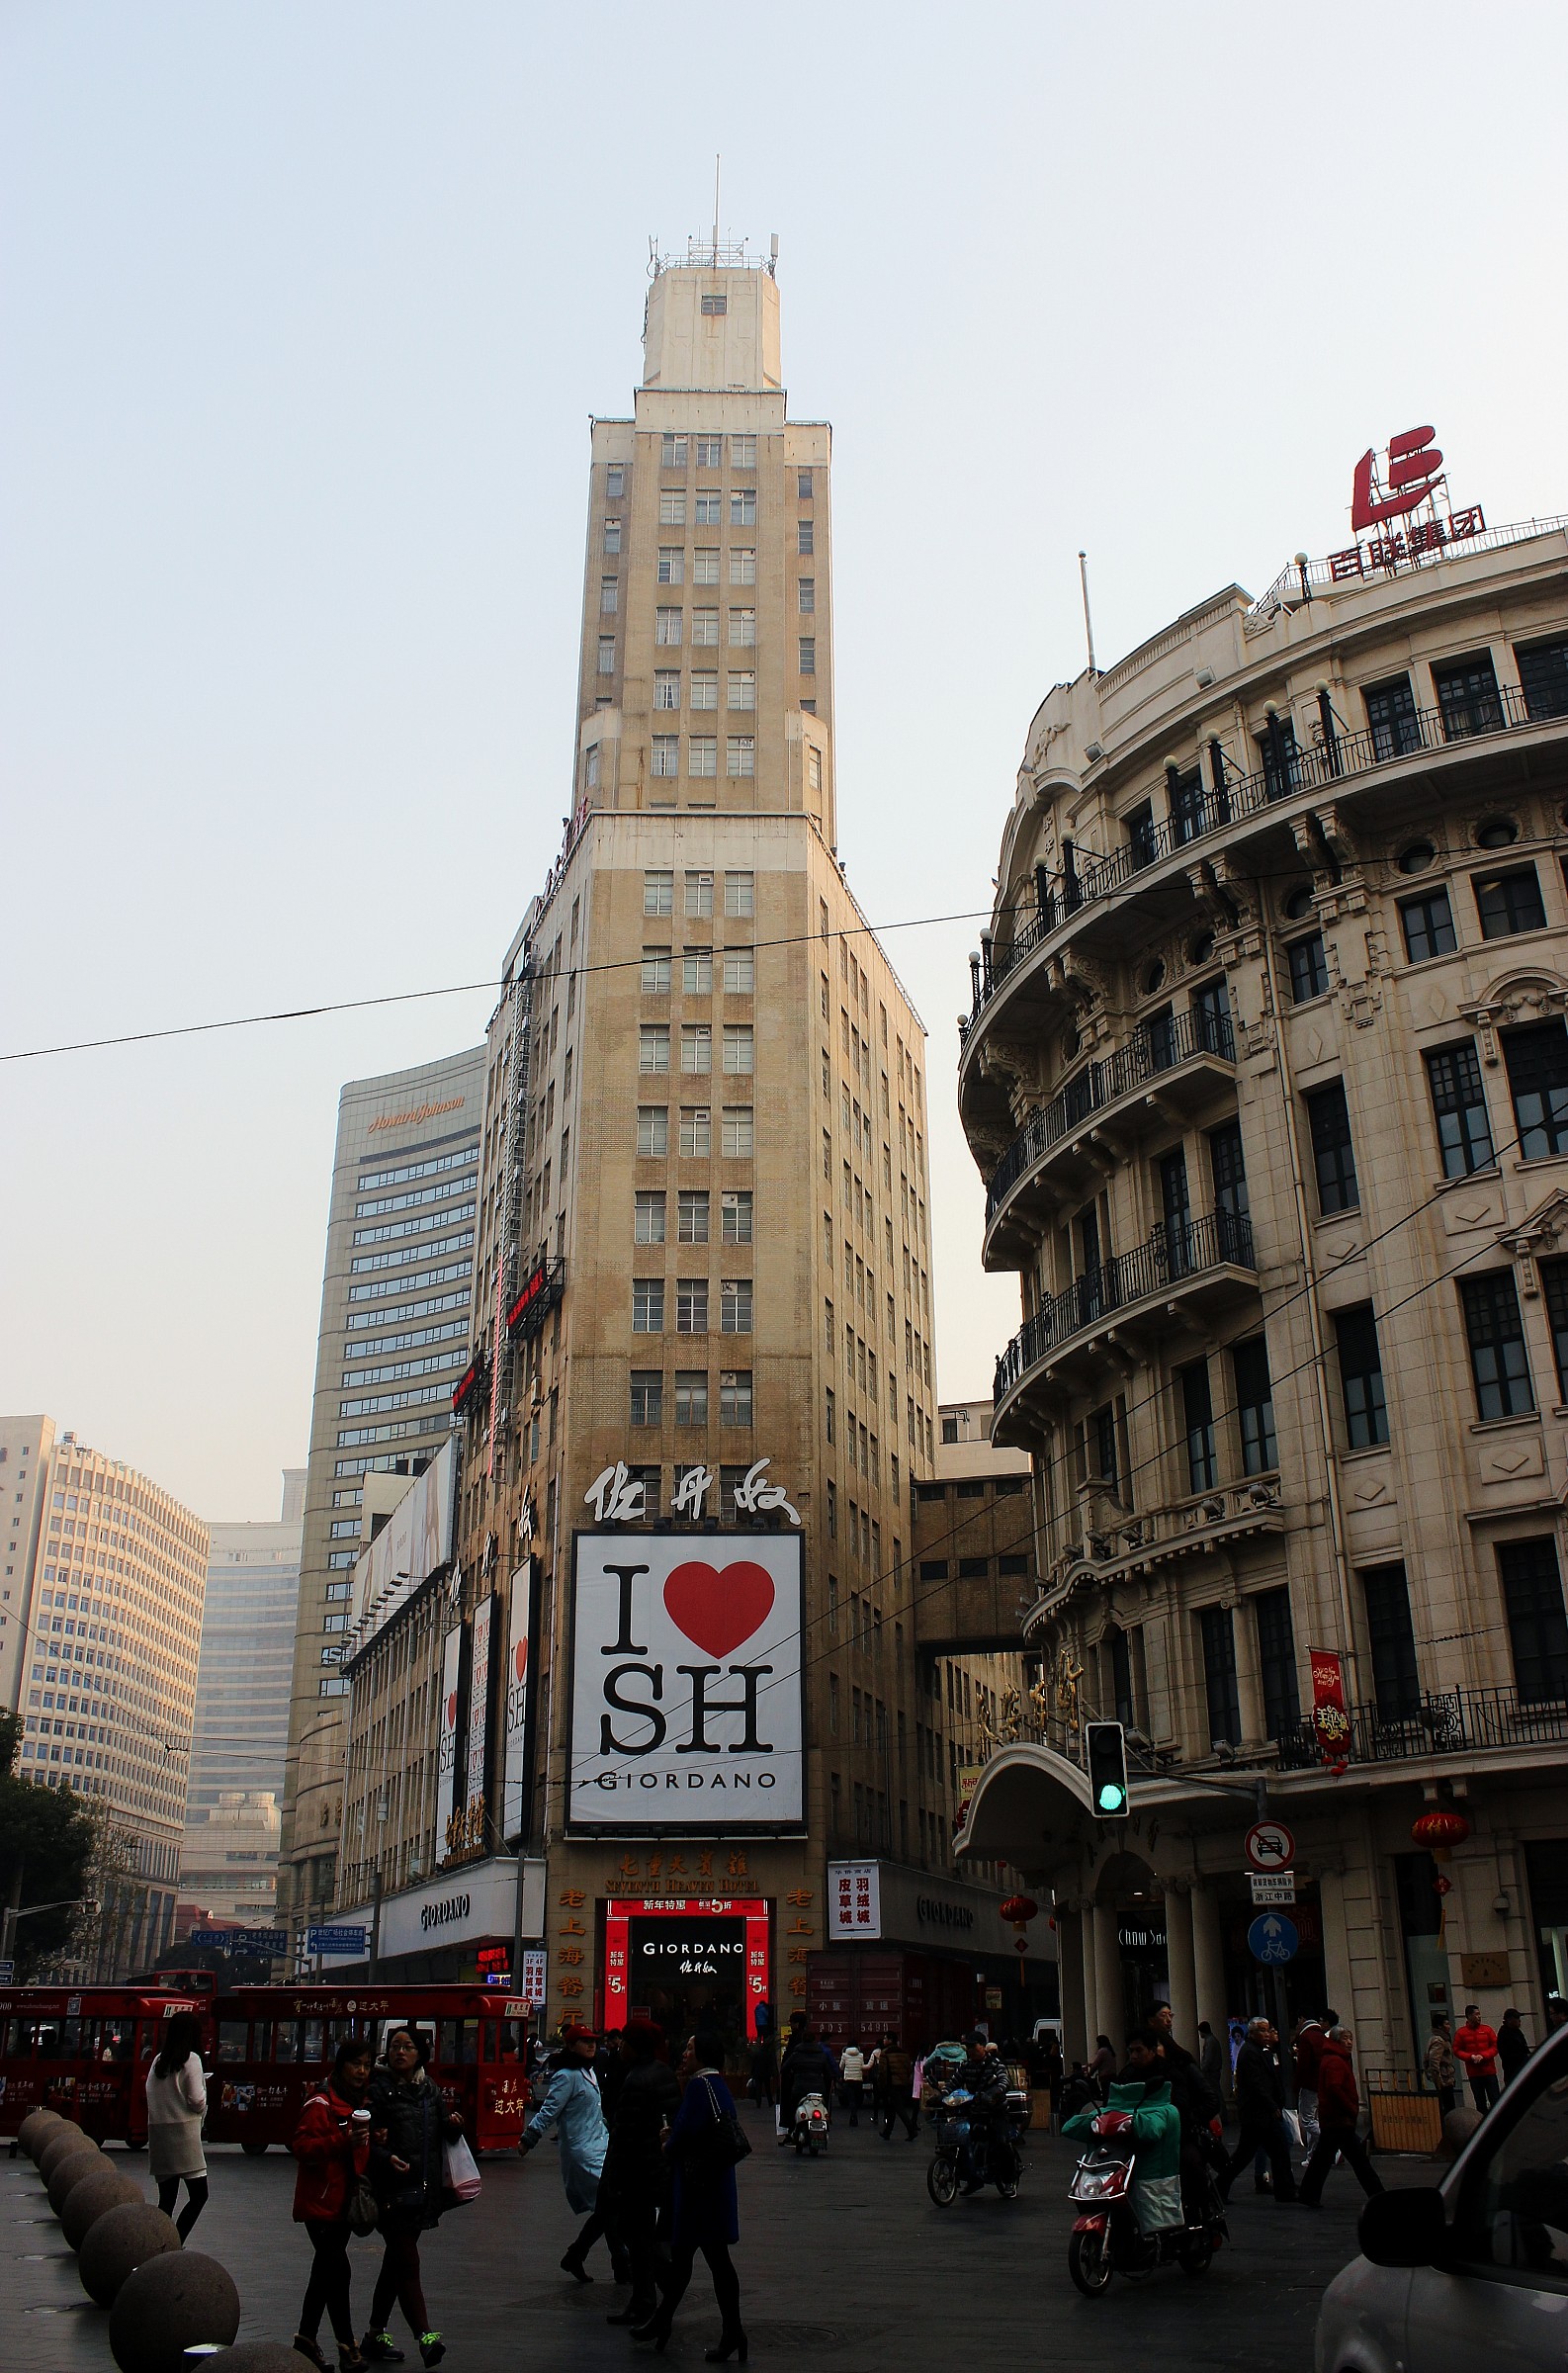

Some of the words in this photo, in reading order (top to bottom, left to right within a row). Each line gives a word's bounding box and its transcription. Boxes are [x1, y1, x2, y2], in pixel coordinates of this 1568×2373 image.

[1328, 504, 1487, 582] 百联集团
[368, 1107, 419, 1133] Howard
[416, 1096, 465, 1124] Johnson
[600, 1564, 650, 1655] I
[508, 1683, 528, 1733] SH
[600, 1663, 774, 1756] SH
[440, 1731, 456, 1774] SH
[597, 1771, 777, 1792] GIORDANO
[605, 1880, 660, 1893] SEVENTH
[665, 1880, 715, 1893] HEAVEN
[719, 1880, 760, 1893] HOTEL
[644, 1899, 686, 1910] 新年特惠
[838, 1878, 853, 1924] 皮草城
[856, 1878, 871, 1924] 羽绒城
[1255, 1891, 1292, 1901] 浙江中路
[421, 1893, 471, 1931] GIORDANO
[310, 1929, 317, 1939] P
[643, 1943, 743, 1955] GIORDANO
[786, 1889, 814, 2013] 老上海餐
[557, 1888, 586, 2025] 老上海餐厅
[359, 2000, 390, 2013] 过大年
[493, 2097, 525, 2118] 过大年
